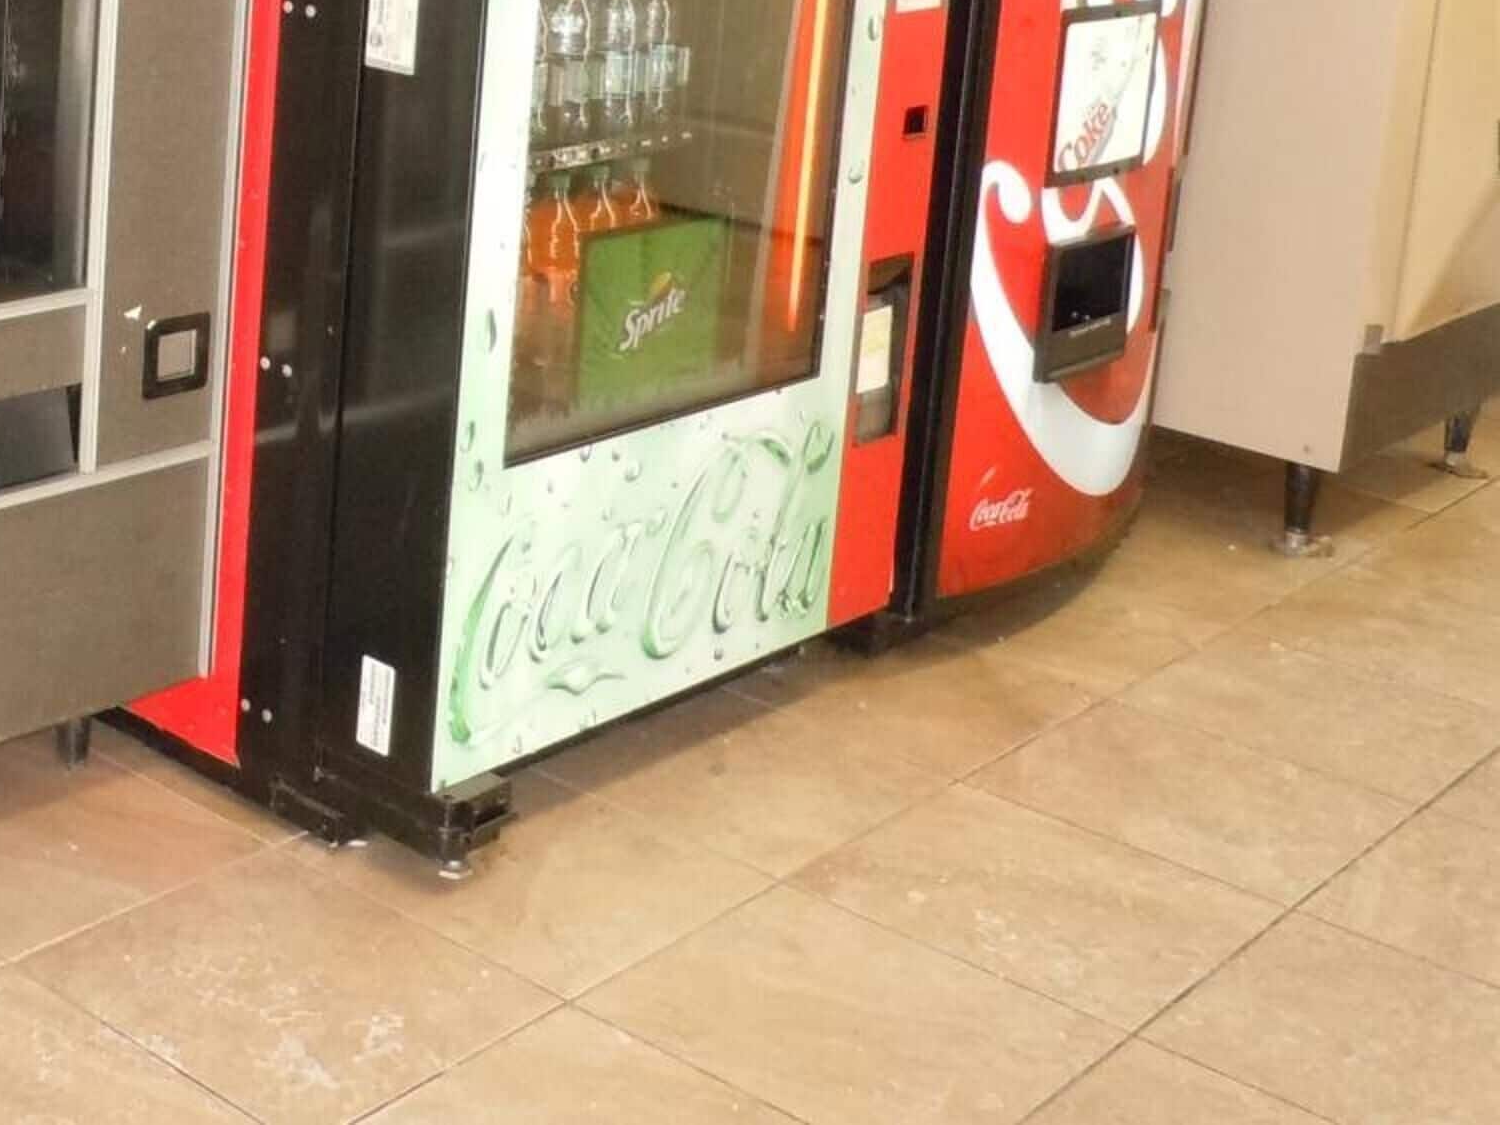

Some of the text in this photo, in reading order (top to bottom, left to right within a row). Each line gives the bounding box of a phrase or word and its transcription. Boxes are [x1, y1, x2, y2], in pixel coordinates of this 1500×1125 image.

[1058, 102, 1110, 172] Coke
[618, 286, 686, 352] Sprite
[969, 486, 1034, 532] Coca-Cola
